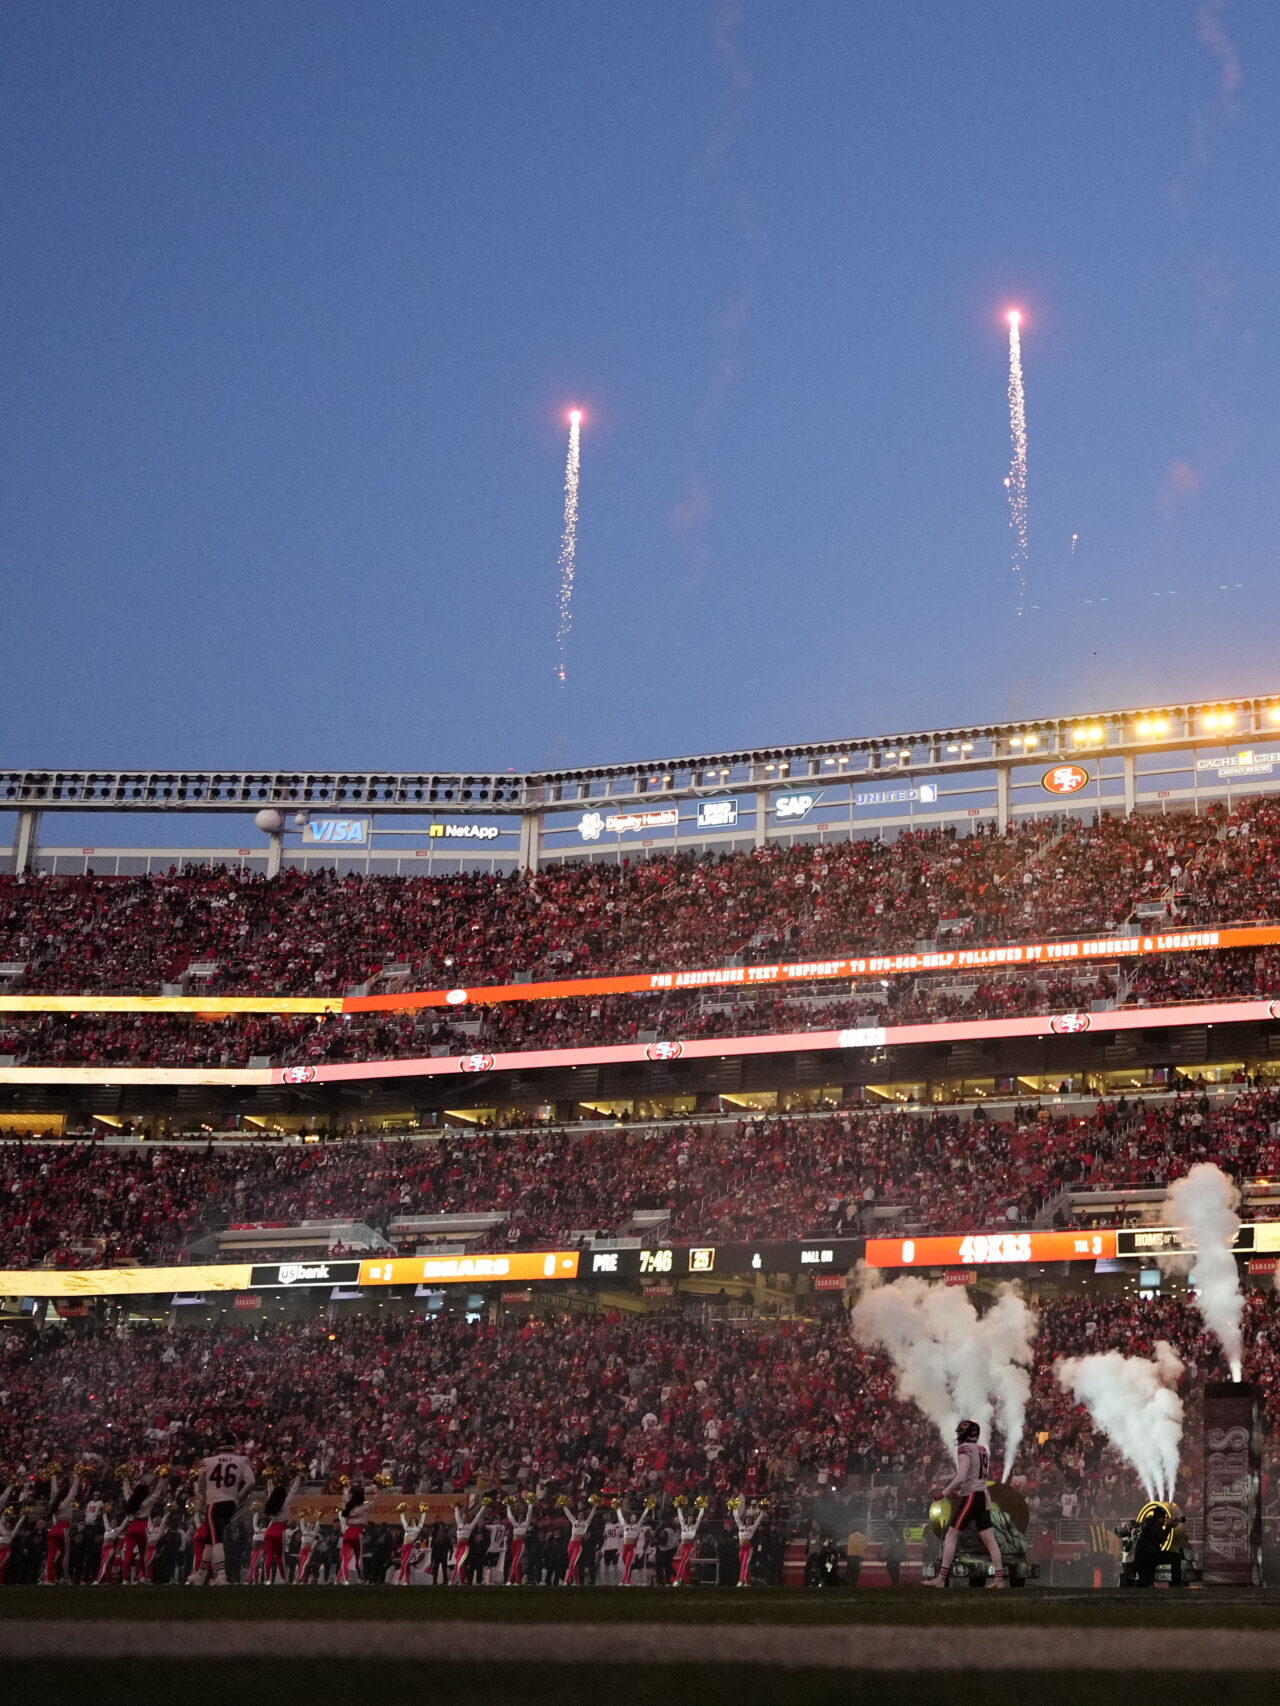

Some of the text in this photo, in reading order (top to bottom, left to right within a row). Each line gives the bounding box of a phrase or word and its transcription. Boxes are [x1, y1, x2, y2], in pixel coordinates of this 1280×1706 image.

[1199, 757, 1238, 769] CACHE
[1219, 765, 1271, 777] CASINO RESORT
[856, 789, 917, 805] UNITED
[704, 802, 731, 815] BUD
[775, 796, 812, 817] SAP
[607, 811, 675, 832] Dignity Health
[699, 811, 736, 826] LIGHT
[310, 821, 363, 841] VISA
[446, 825, 499, 840] NetApp
[651, 975, 672, 988] FOR
[676, 969, 743, 985] ASSISTANCE
[748, 966, 778, 980] TEXT
[851, 959, 865, 973] TO
[958, 948, 1022, 965] FOLLOWED
[1026, 946, 1042, 959] BY
[1047, 943, 1078, 957] YOUR
[1082, 938, 1139, 955] CONCERN
[1143, 937, 1153, 950] &
[1157, 933, 1219, 949] LOCATION
[1135, 1233, 1164, 1247] HOME
[593, 1254, 619, 1272] PRE
[639, 1250, 673, 1272] 7:46
[752, 1253, 762, 1268] &
[801, 1251, 820, 1264] BALL
[299, 1264, 330, 1280] bank
[209, 1463, 238, 1488] 46
[1207, 1426, 1249, 1560] 49ERS
